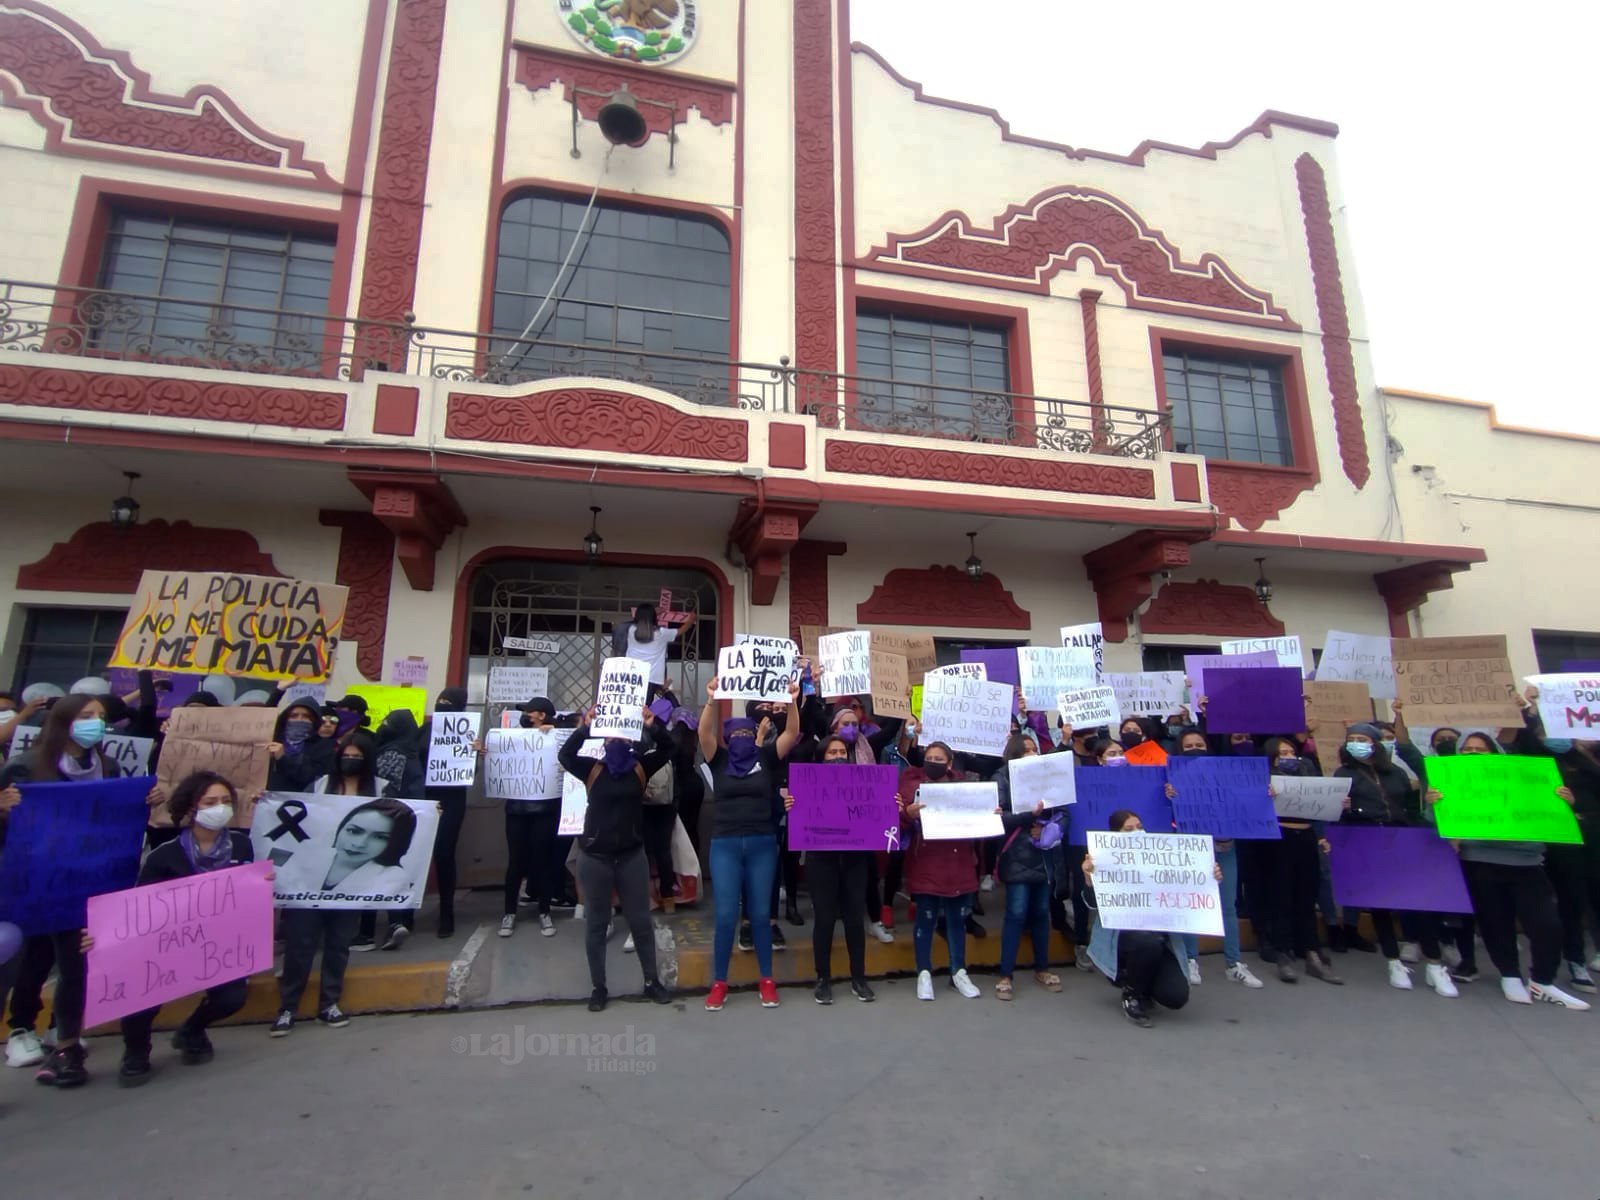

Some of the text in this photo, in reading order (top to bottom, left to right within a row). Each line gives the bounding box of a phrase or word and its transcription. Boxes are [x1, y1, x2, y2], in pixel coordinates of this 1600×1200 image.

[159, 575, 321, 614] LA POLICÍA
[139, 611, 338, 649] NO ME CUIDA,
[509, 639, 553, 651] SALIDA
[1231, 639, 1298, 657] JUSTICIA
[727, 650, 746, 669] LA
[604, 672, 644, 687] SALVABA
[943, 665, 982, 676] POR ELLA
[601, 685, 636, 696] VIDAS Y
[721, 668, 783, 697] mata
[880, 680, 898, 691] NOS
[597, 703, 622, 716] SE LA
[599, 694, 646, 707] USTEDES
[443, 717, 470, 735] NO
[433, 737, 462, 746] HABRA
[524, 735, 544, 753] NO
[430, 760, 448, 770] SIN
[532, 757, 545, 777] LA
[431, 767, 474, 783] JUSTICIA
[489, 776, 546, 797] MATARON
[1095, 834, 1209, 853] REQUISITOS PARA
[1112, 853, 1136, 866] SER
[273, 891, 410, 904] usticiaParaBety
[114, 874, 236, 941] JUSTICIA
[159, 923, 205, 955] PARA
[98, 974, 127, 1005] La
[142, 960, 177, 997] Dra
